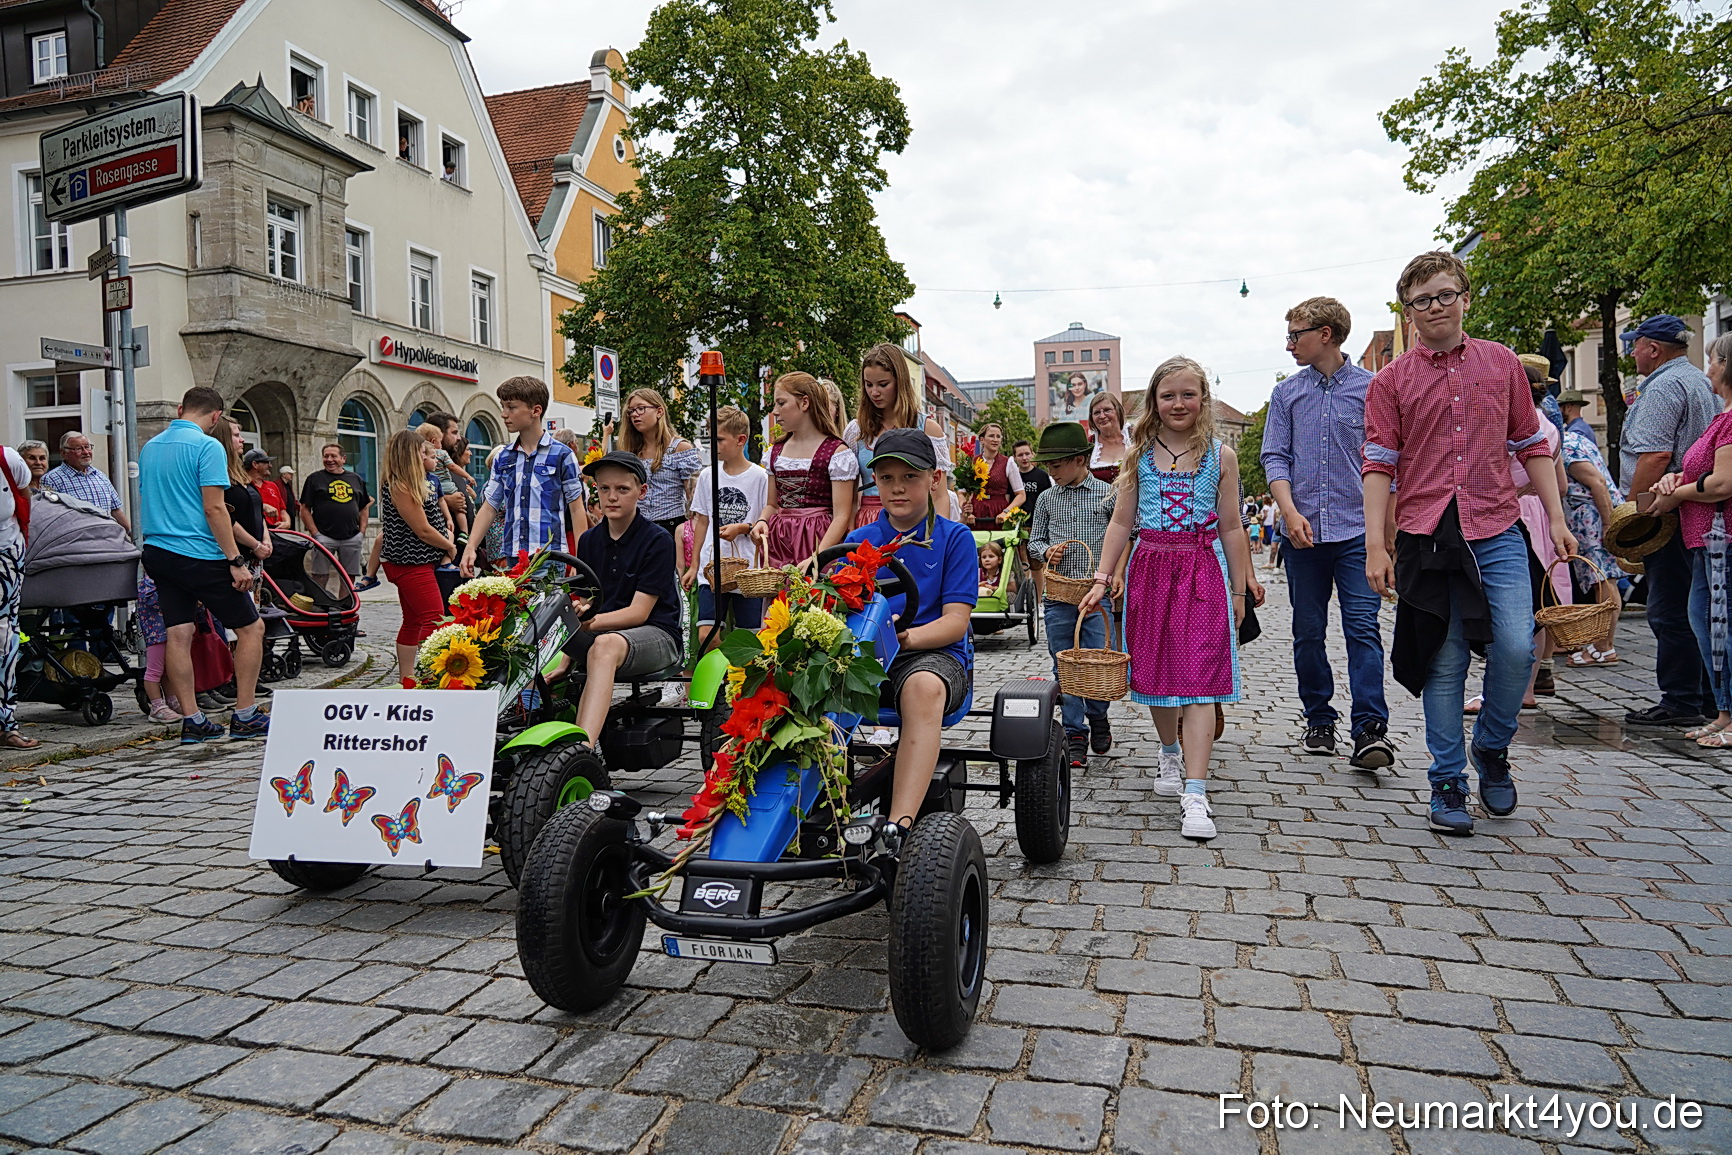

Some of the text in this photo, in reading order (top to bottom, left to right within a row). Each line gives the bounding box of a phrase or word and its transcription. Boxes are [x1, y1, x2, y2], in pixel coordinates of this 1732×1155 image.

[62, 116, 156, 160] Parkleitsystem
[95, 157, 158, 188] Rosengasse
[394, 340, 479, 375] HypoVereinsbank
[324, 704, 369, 721] OGV
[386, 704, 434, 722] Kids
[323, 733, 429, 752] Rittershof
[693, 887, 742, 902] BERG
[691, 943, 754, 960] FLORIAN
